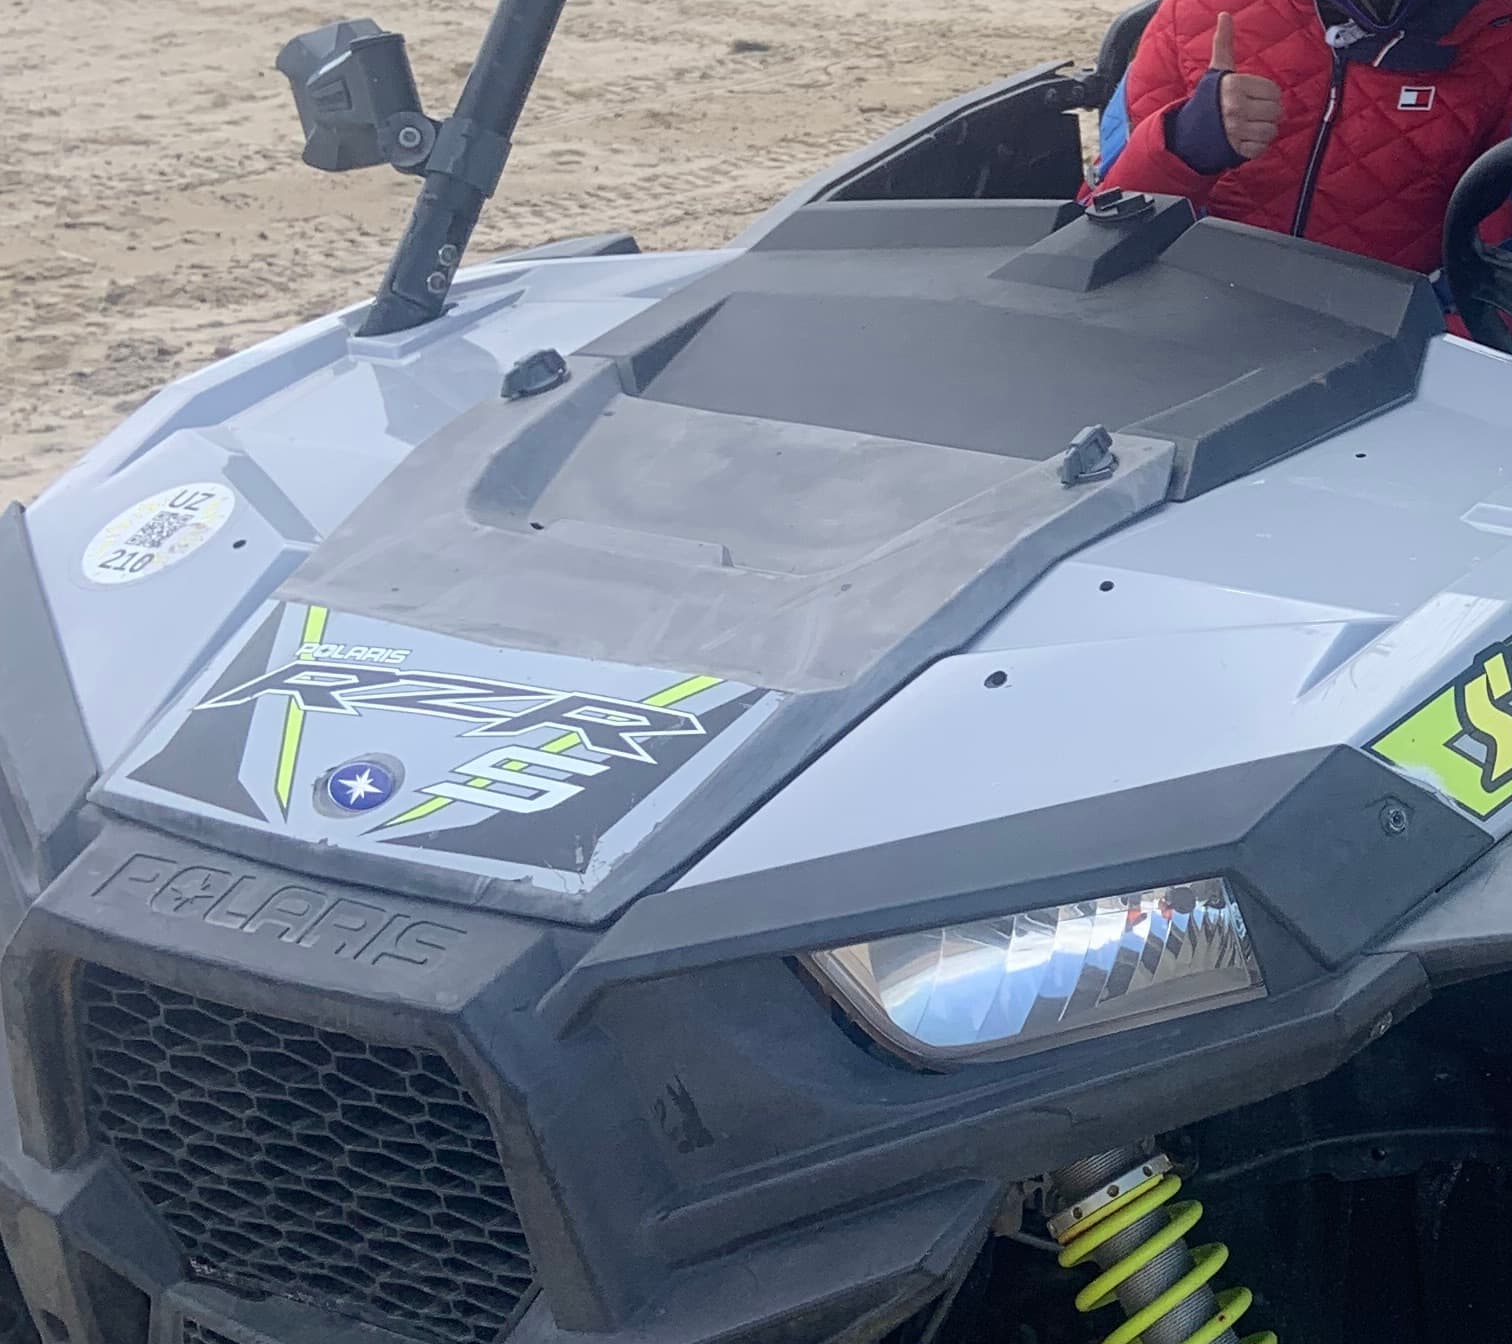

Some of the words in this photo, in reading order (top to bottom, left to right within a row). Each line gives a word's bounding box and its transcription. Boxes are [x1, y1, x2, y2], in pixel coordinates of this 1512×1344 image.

[168, 489, 216, 512] UZ
[97, 548, 155, 573] 210
[294, 642, 411, 665] POLARIS
[187, 659, 707, 764] RZR
[90, 853, 470, 968] POLARIS
